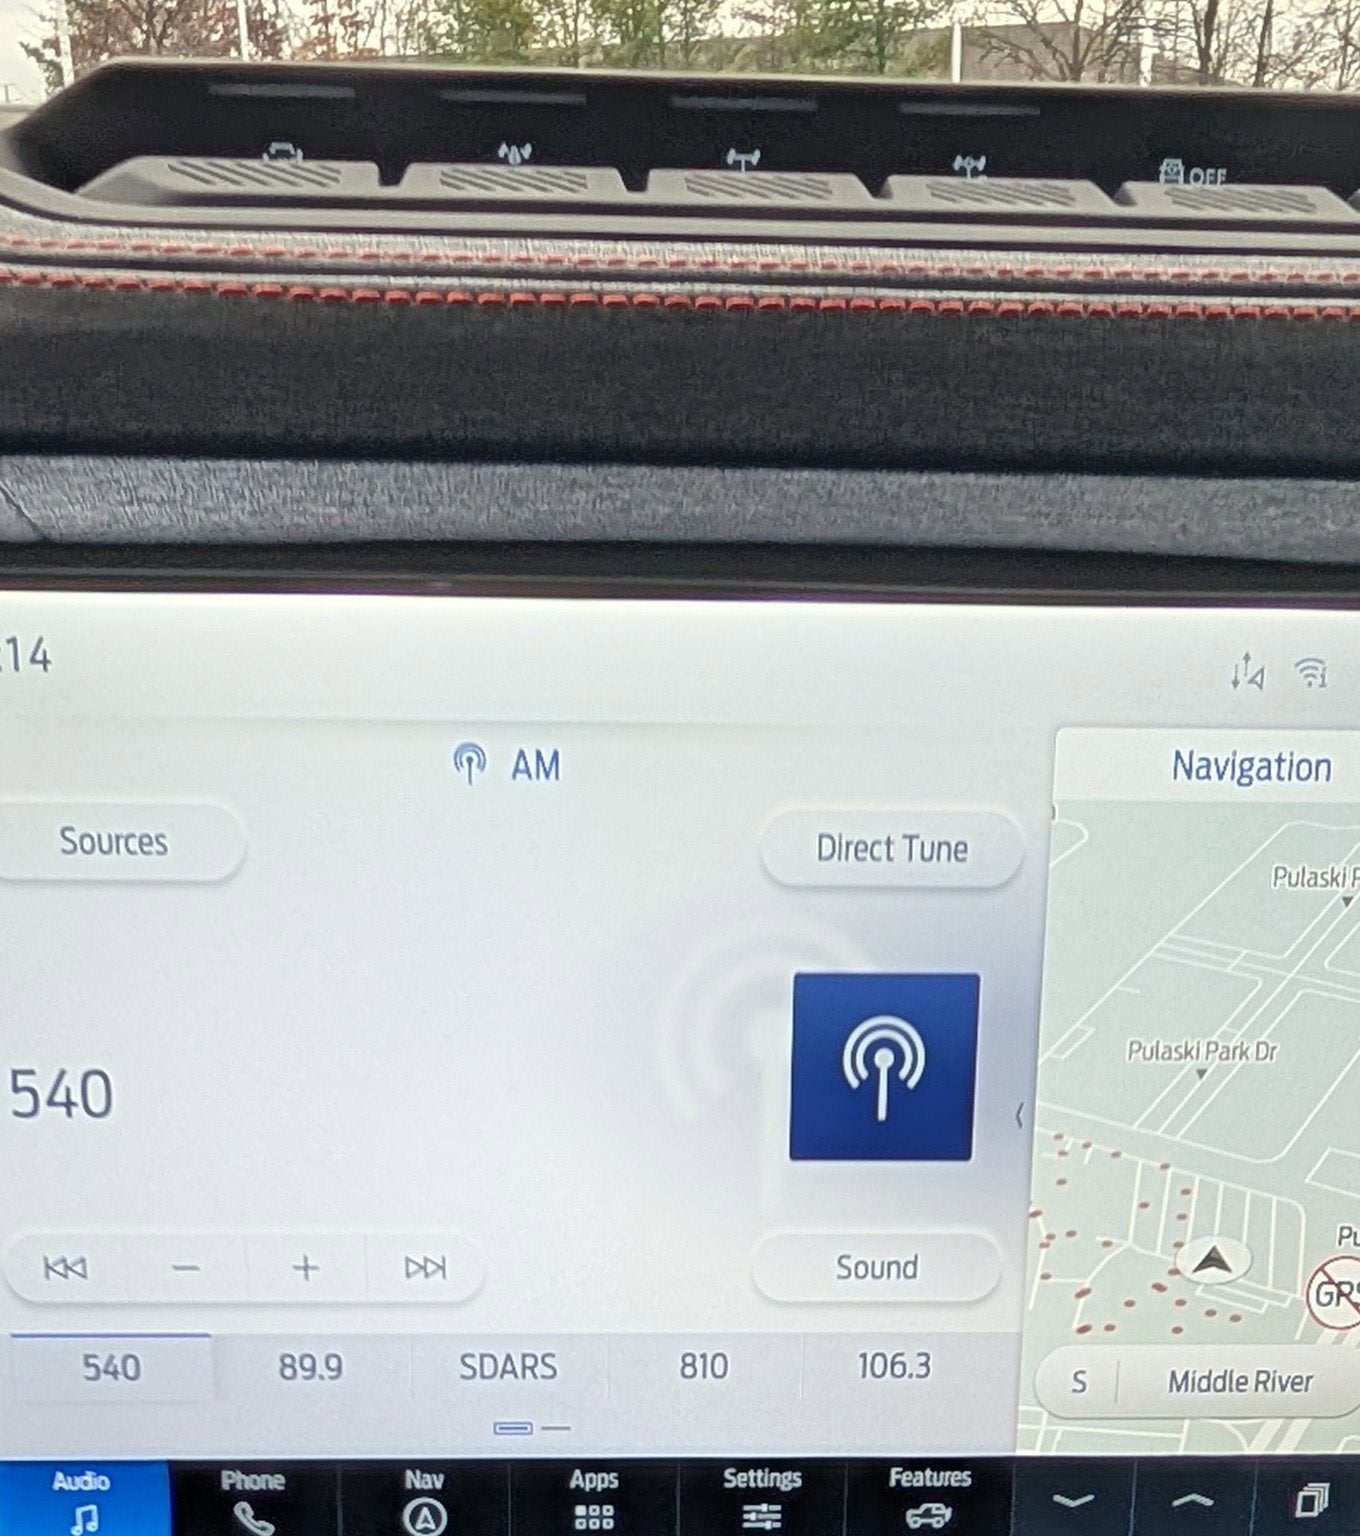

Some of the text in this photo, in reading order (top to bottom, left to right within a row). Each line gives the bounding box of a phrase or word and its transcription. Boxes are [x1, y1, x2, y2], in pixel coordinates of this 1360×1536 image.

[1189, 167, 1227, 187] OFF
[511, 747, 562, 783] AM
[1171, 749, 1333, 786] Navigation
[58, 825, 170, 858] Sources
[816, 832, 969, 866] Direct Tune
[1271, 864, 1348, 891] Pulaski
[1126, 1039, 1279, 1064] Pulaski Park Dr
[9, 1068, 113, 1119] 540
[836, 1253, 920, 1283] Sound
[82, 1353, 142, 1382] 540
[278, 1352, 344, 1381] 89.9
[458, 1352, 559, 1380] SDARS
[678, 1351, 730, 1380] 810
[857, 1351, 932, 1381] 106.3
[1071, 1370, 1089, 1394] S
[1166, 1368, 1315, 1394] Middle River
[51, 1470, 112, 1492] Audio
[220, 1468, 287, 1492] Phone
[404, 1469, 446, 1491] Nav
[568, 1468, 620, 1495] Apps
[722, 1466, 803, 1493] Settings
[889, 1466, 973, 1489] Features
